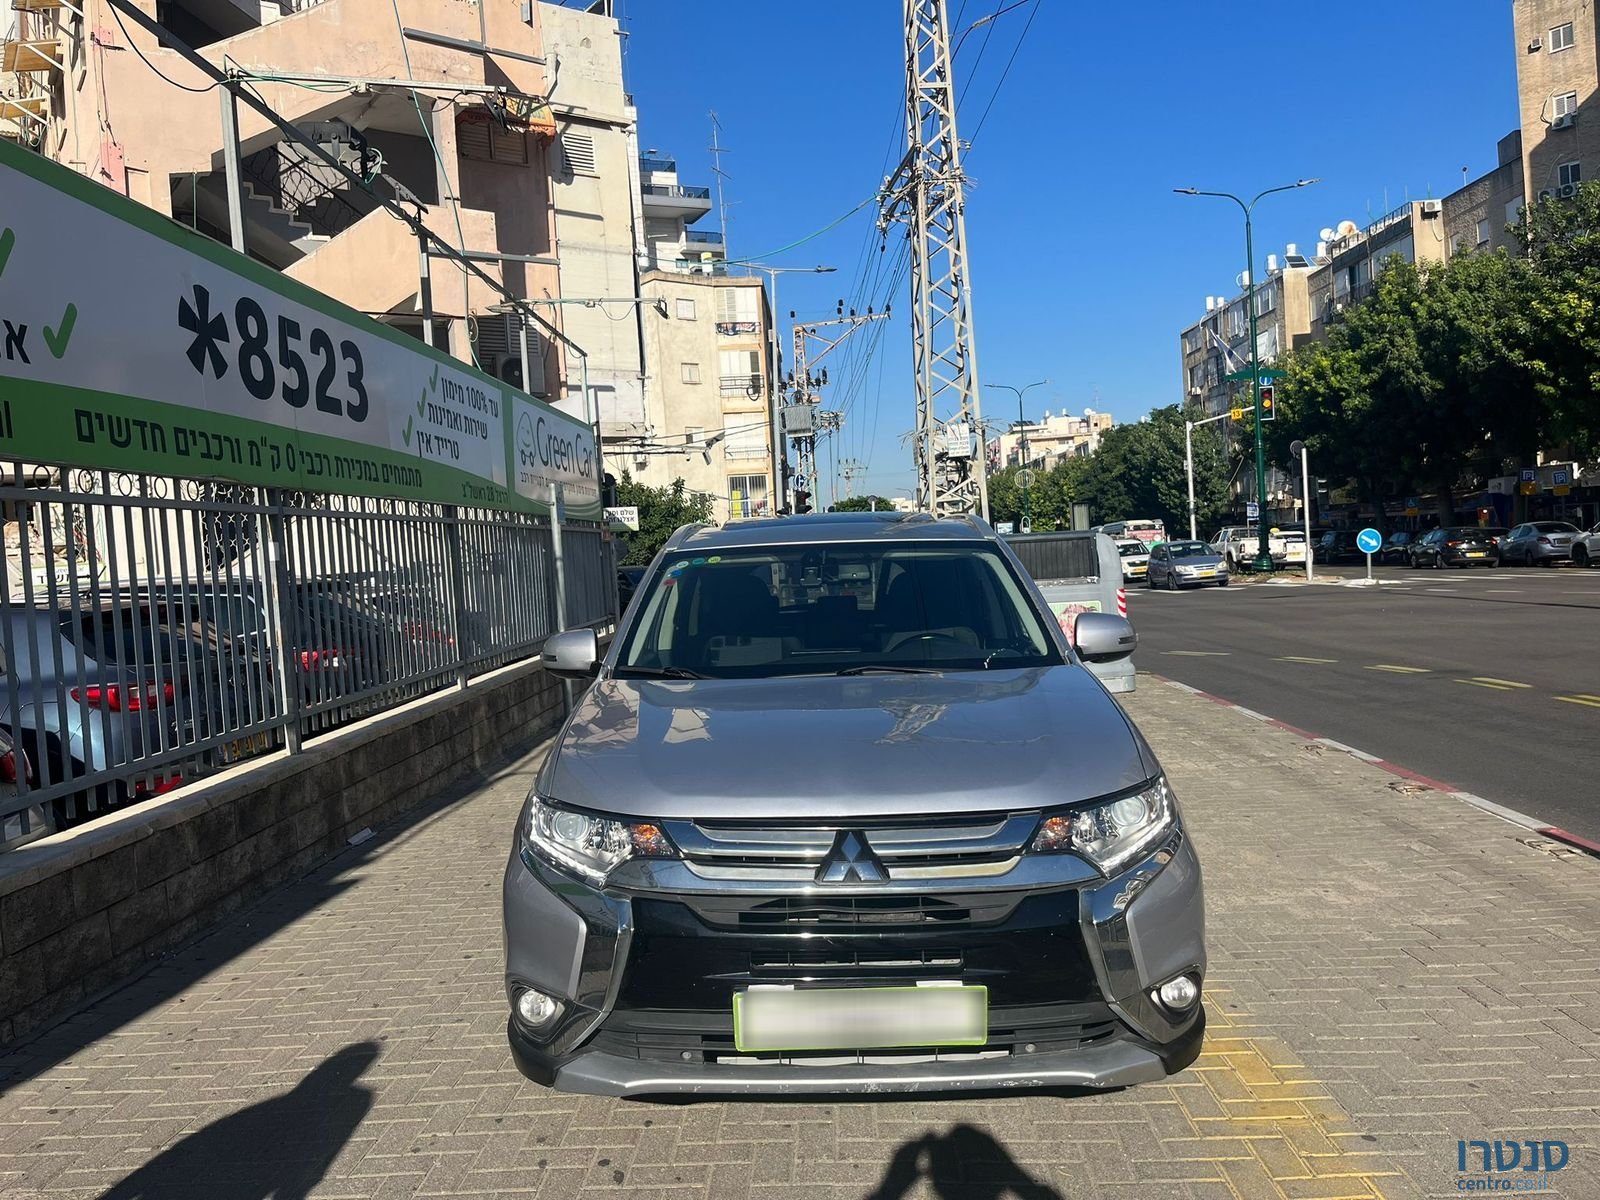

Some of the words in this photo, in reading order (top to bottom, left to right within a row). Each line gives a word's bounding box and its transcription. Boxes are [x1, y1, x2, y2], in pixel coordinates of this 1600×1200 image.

[441, 377, 465, 404] מימון
[466, 385, 489, 414] 100%
[427, 402, 463, 432] ואמינות
[488, 398, 499, 418] עד
[1232, 410, 1241, 419] 13
[74, 408, 167, 454] חדשים
[463, 415, 488, 441] שירות
[173, 426, 243, 464] ורכבים
[286, 443, 296, 472] 0
[416, 430, 433, 458] אין
[434, 435, 460, 460] טרייד
[536, 416, 576, 474] Green
[575, 432, 593, 479] Car
[299, 449, 332, 477] רכבי
[334, 455, 380, 483] במכירת
[381, 463, 422, 488] מתמחים
